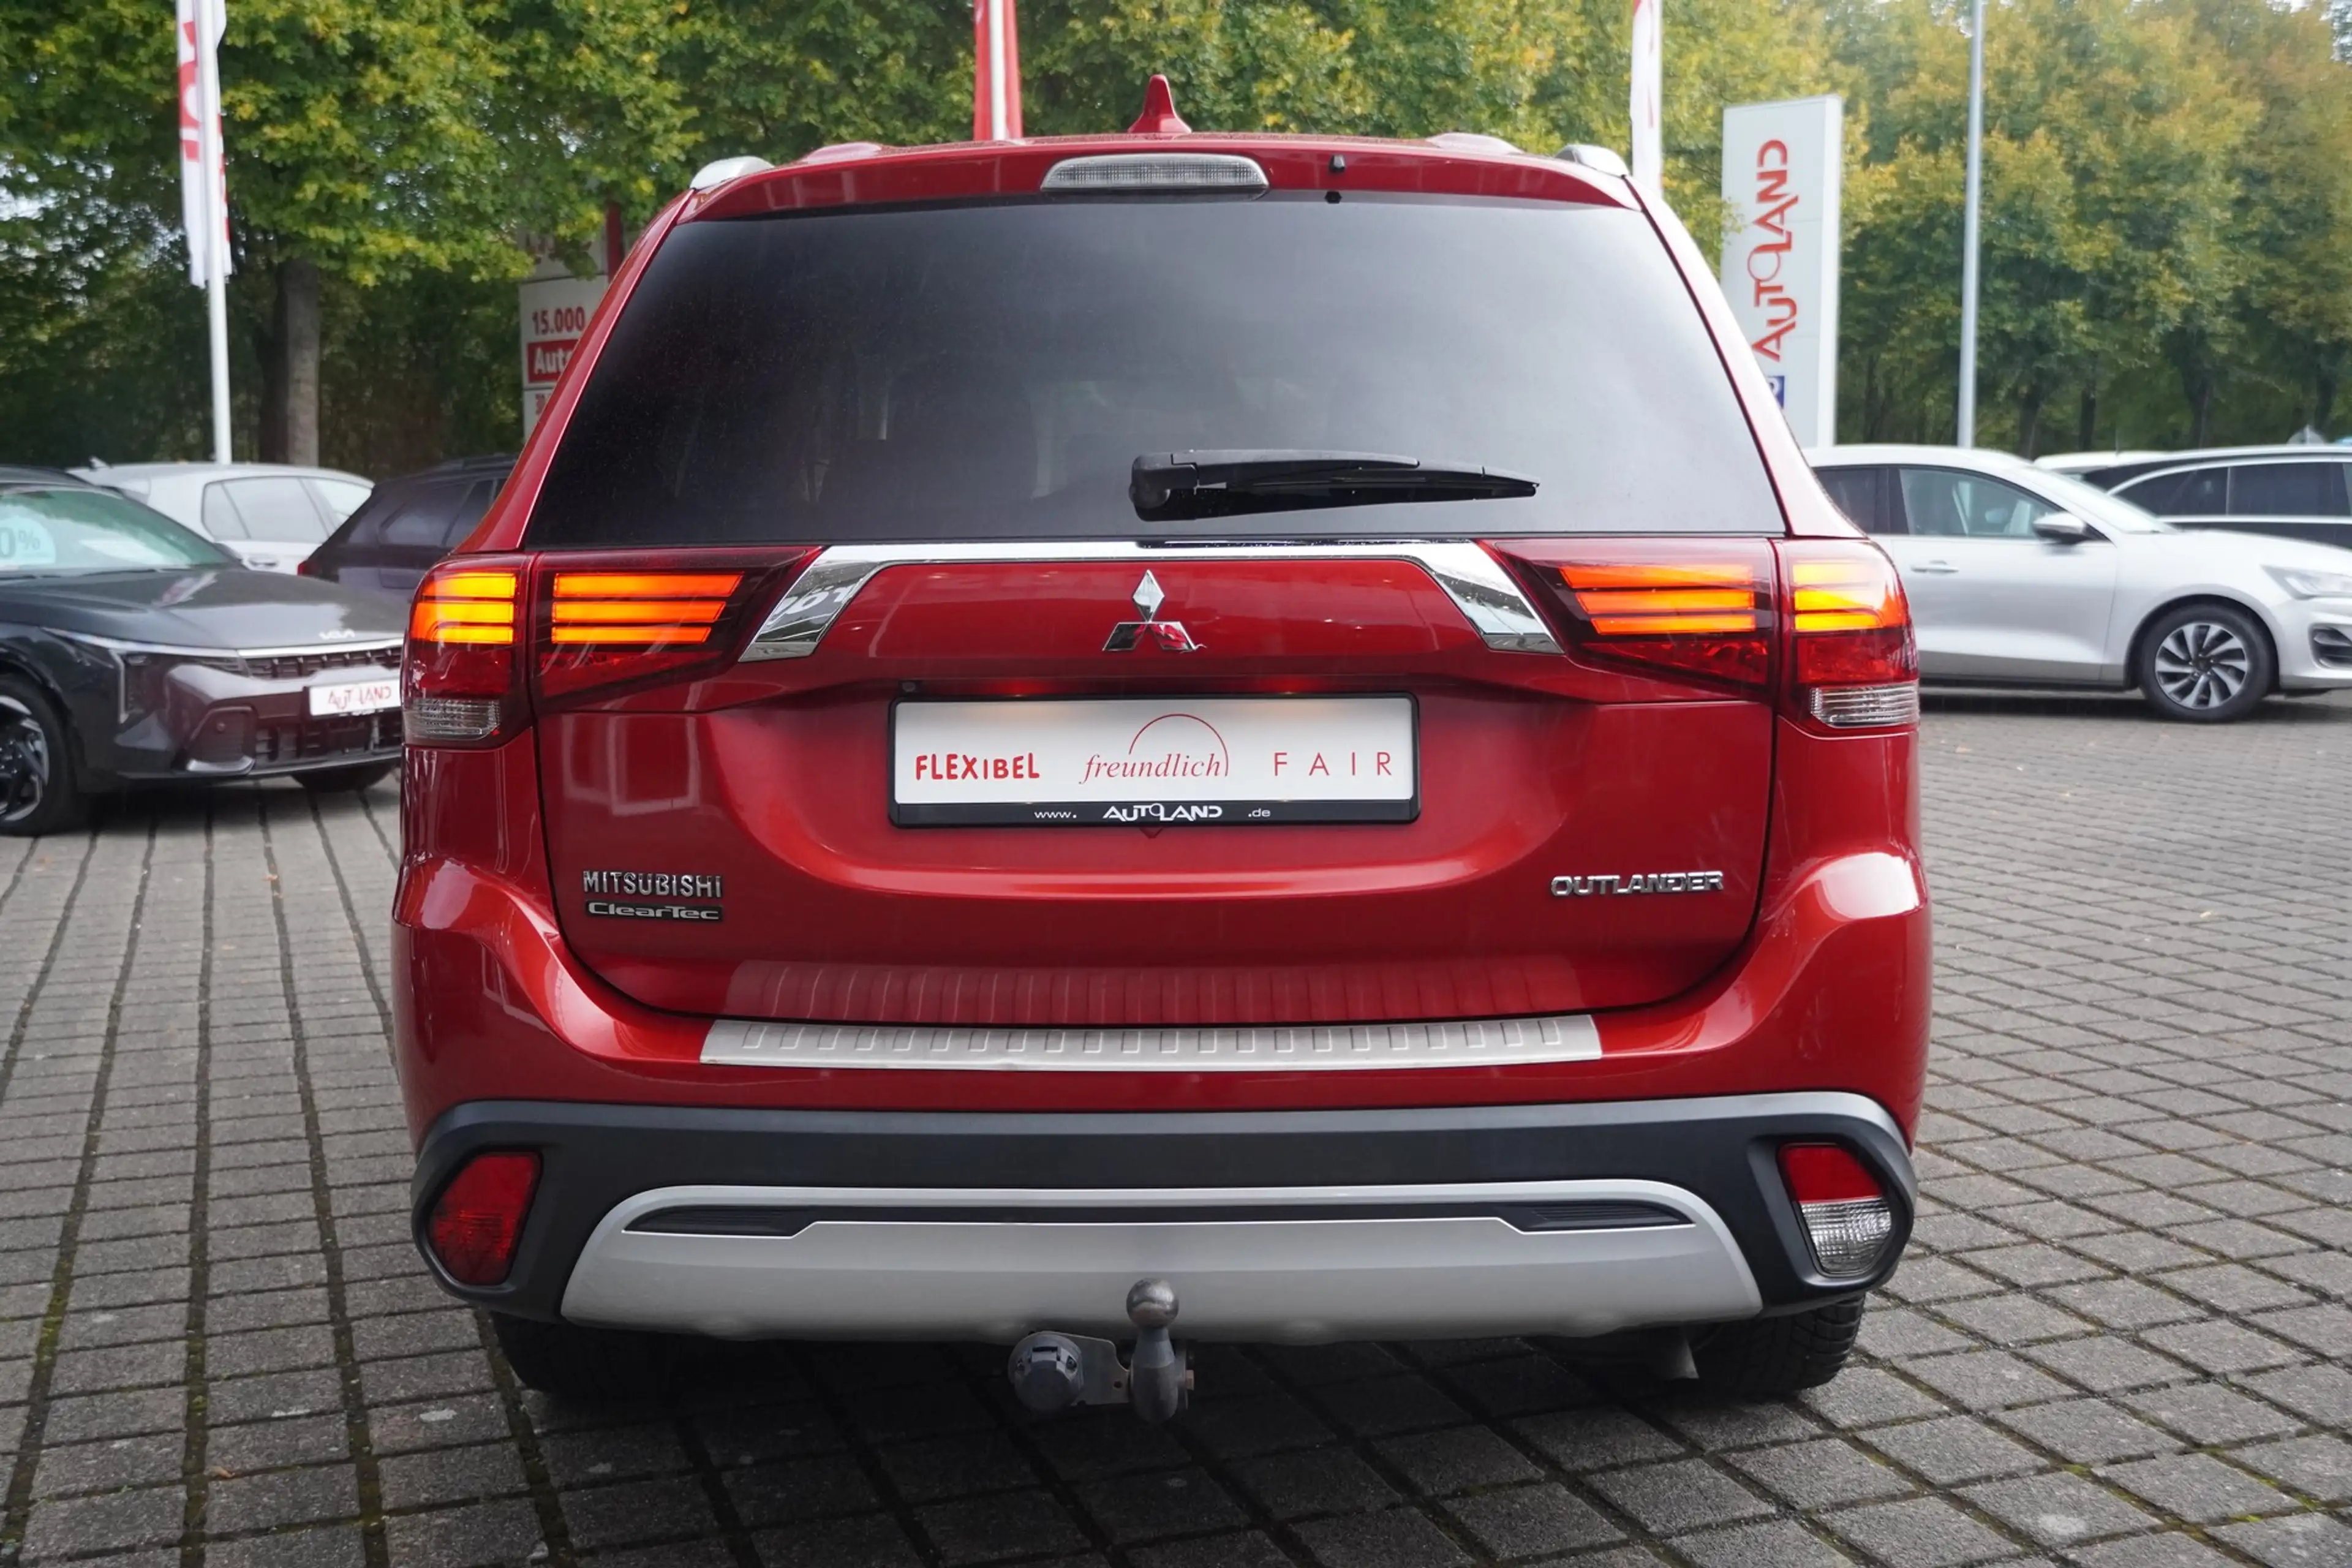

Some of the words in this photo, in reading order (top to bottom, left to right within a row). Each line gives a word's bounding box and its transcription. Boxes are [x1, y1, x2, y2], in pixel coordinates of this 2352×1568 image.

[1747, 139, 1799, 363] AUTOLAND
[532, 306, 586, 336] 15.000
[328, 685, 392, 710] AUTLAND
[916, 752, 1040, 781] FLEXIBEL
[1078, 753, 1221, 785] freundlich
[1274, 752, 1392, 777] FAIR
[1034, 810, 1077, 820] www.
[1102, 802, 1223, 823] AUTOLAND
[1248, 807, 1272, 818] .de
[583, 870, 722, 898] MITSUBISHI
[1551, 870, 1724, 896] OUTLANDER
[588, 901, 720, 920] ClearTec
